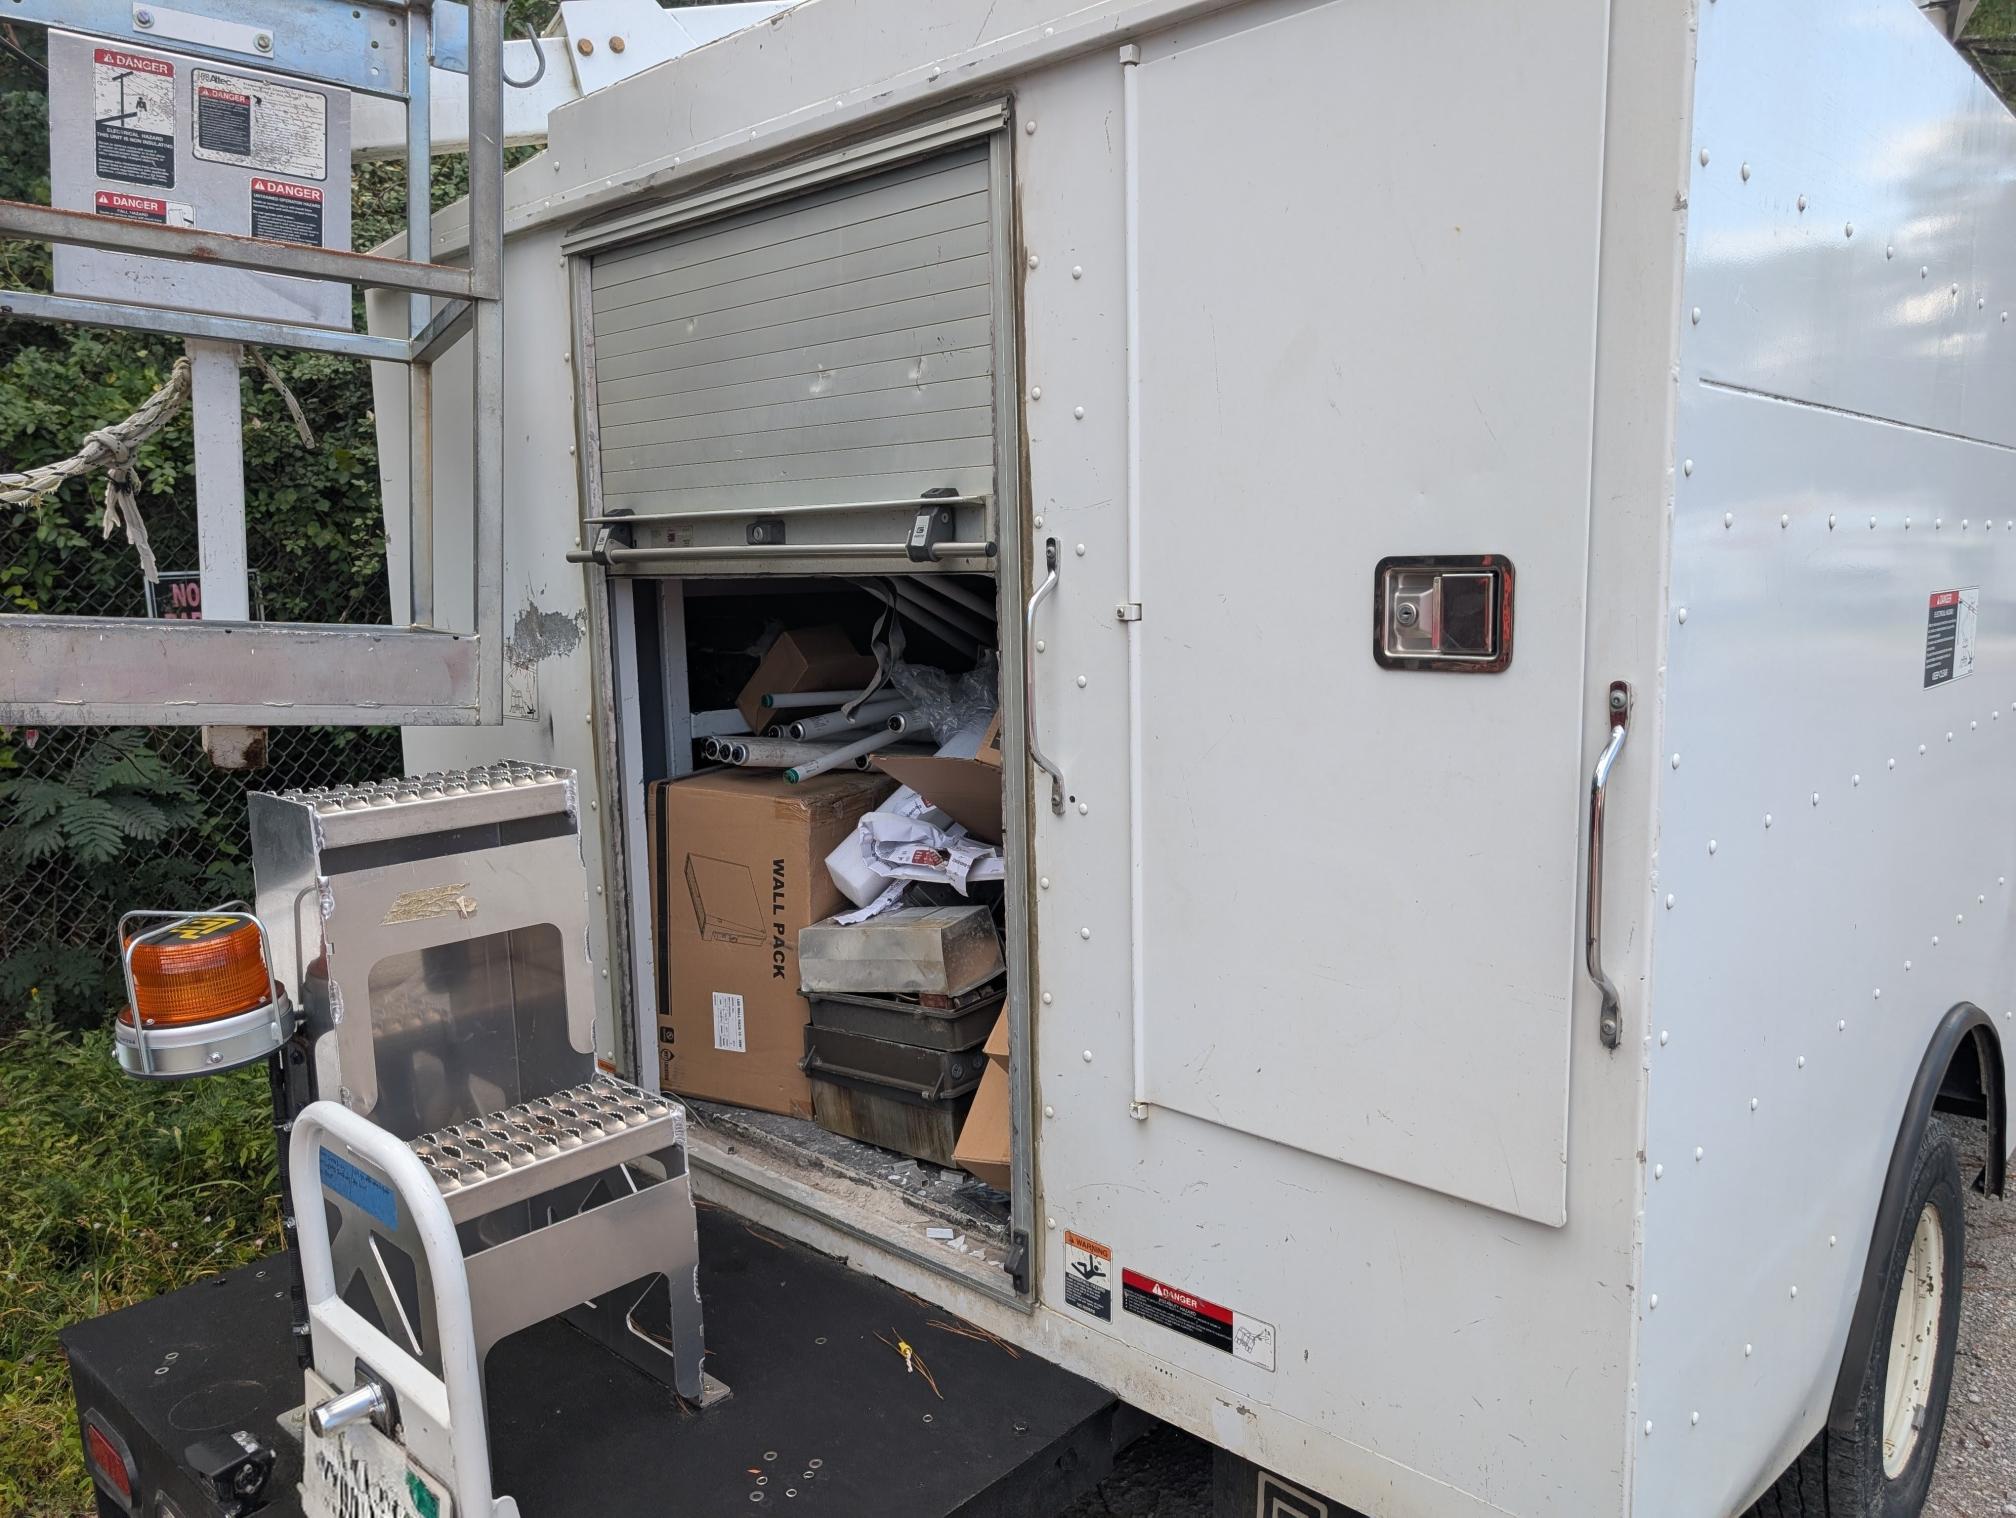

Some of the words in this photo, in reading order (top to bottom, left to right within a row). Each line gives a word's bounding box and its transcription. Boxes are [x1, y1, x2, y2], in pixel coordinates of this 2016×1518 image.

[117, 55, 168, 74] DANGER
[212, 90, 245, 102] DANGER
[267, 182, 320, 200] DANGER
[113, 196, 158, 211] DANGER
[172, 582, 200, 608] NO
[772, 858, 785, 915] WALL
[772, 922, 786, 980] PACK
[1076, 1239, 1108, 1258] WARNING
[1162, 1288, 1198, 1309] DANGER
